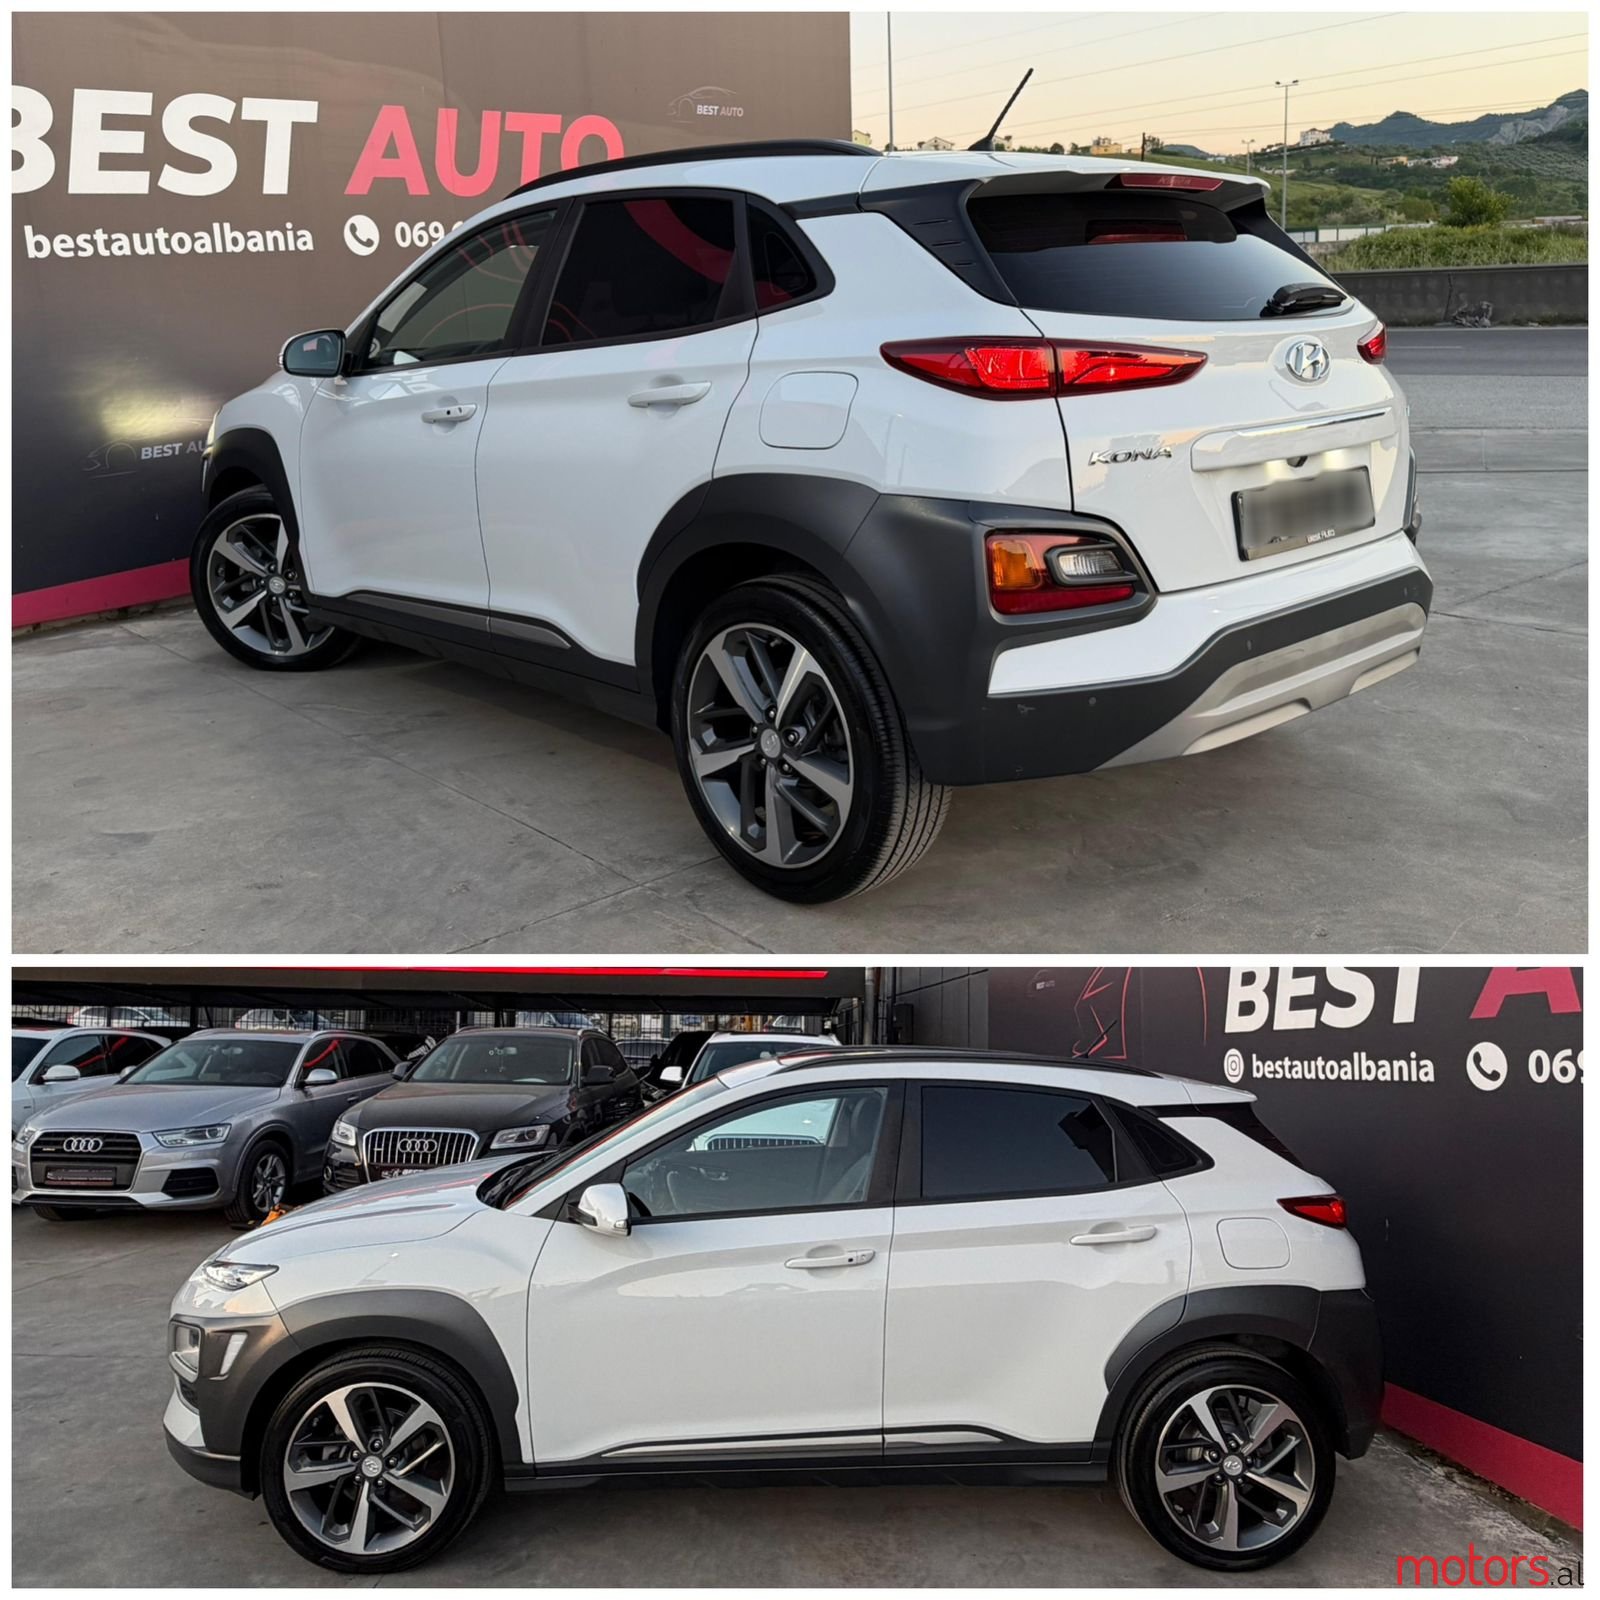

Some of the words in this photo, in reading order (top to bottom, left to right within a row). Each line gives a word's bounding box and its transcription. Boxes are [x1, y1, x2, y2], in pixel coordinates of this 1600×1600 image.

[696, 104, 720, 116] BEST
[720, 106, 744, 118] AUTO
[343, 104, 625, 198] AUTO
[24, 222, 315, 259] bestautoalbania
[394, 220, 445, 248] 069
[141, 443, 183, 460] BEST
[1088, 447, 1173, 466] KONA
[1251, 1051, 1436, 1083] bestautoalbania
